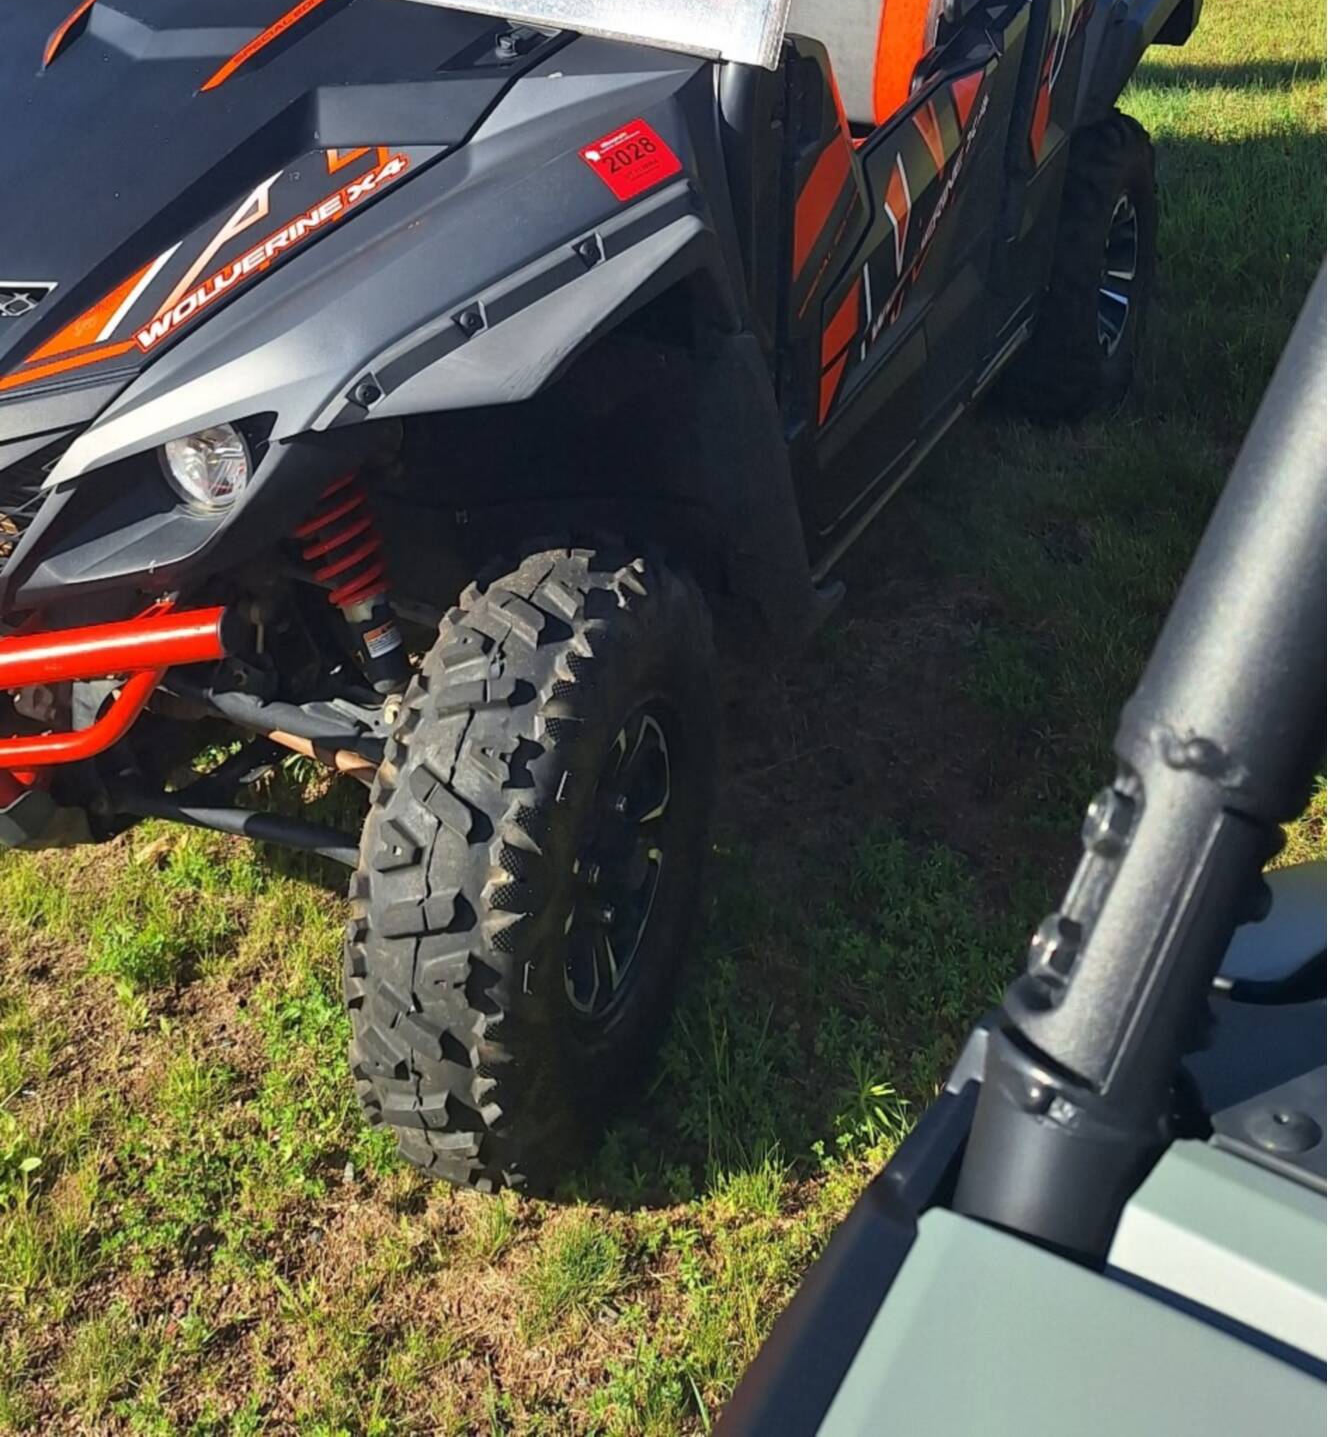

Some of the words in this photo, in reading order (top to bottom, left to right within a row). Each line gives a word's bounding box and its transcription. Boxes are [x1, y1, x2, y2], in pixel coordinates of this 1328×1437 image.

[603, 137, 656, 175] 2028
[136, 193, 344, 349] WOLVERINE
[347, 157, 406, 203] X4
